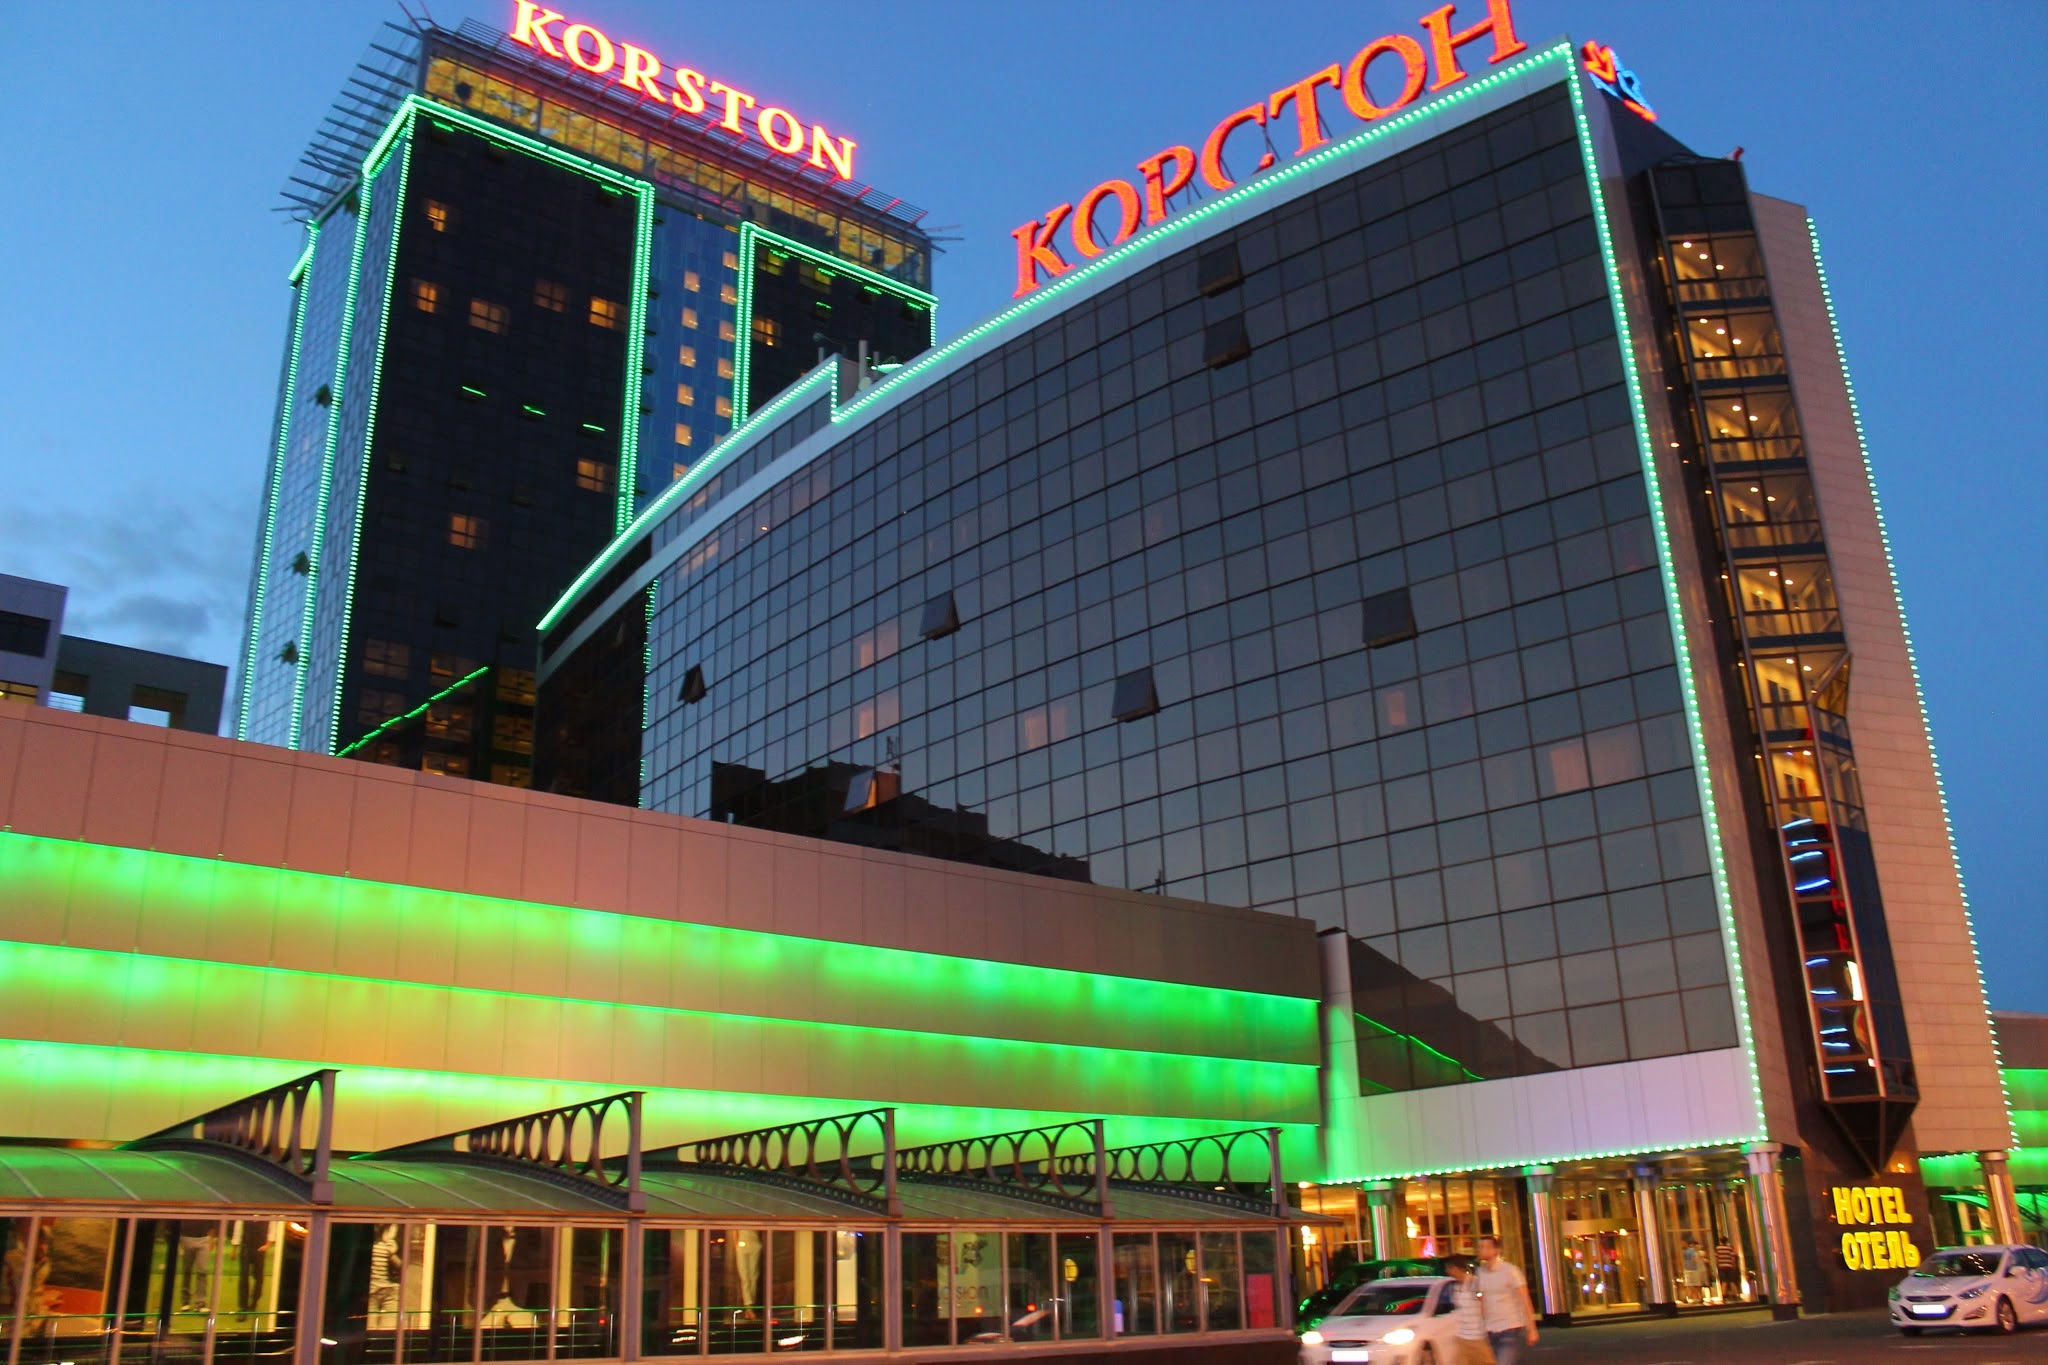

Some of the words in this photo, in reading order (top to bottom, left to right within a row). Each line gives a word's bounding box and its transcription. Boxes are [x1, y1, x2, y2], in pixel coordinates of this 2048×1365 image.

[510, 0, 857, 181] KORSTON
[1010, 0, 1527, 298] КОРСТОН
[1832, 1186, 1913, 1225] HOTEL
[1841, 1230, 1921, 1271] ОТЕЛЬ
